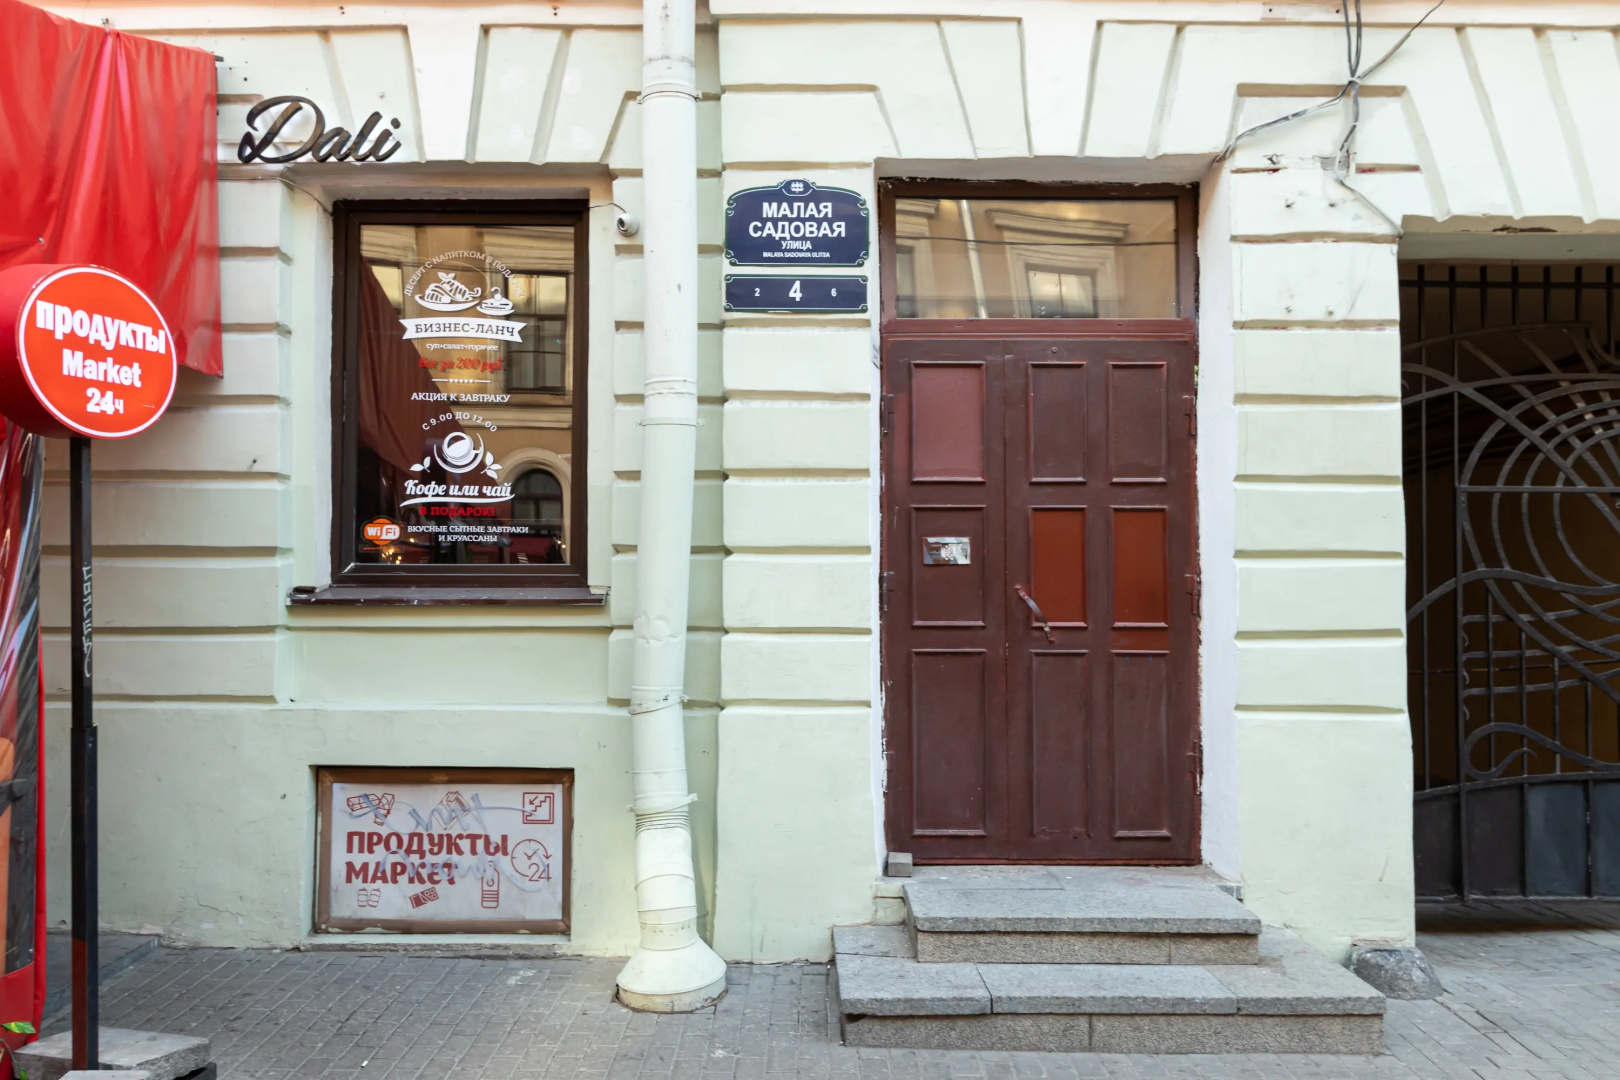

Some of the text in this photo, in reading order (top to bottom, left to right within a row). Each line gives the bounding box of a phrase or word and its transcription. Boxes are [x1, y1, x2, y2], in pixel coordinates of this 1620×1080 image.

[237, 95, 402, 164] Dali
[762, 202, 832, 218] МАЛАЯ
[748, 221, 846, 240] САДОВАЯ
[781, 240, 812, 251] УЛИЦА
[404, 266, 426, 297] ДЕСЕРТ
[425, 261, 433, 269] С
[432, 250, 486, 265] НАПИТКОМ
[486, 255, 493, 264] В
[754, 280, 837, 302] 2 4 6
[36, 300, 166, 354] продукты
[414, 323, 516, 337] БИЗНЕС-ЛАНЧ
[62, 349, 142, 388] Market
[440, 359, 454, 371] за
[455, 357, 479, 370] 200
[85, 387, 124, 415] 24ч
[411, 392, 511, 403] АКЦИЯ К ЗАВТРАКУ
[430, 412, 453, 426] 9.00
[455, 412, 470, 420] ДО
[472, 414, 497, 432] 12.00
[404, 479, 512, 498] Кофе или чай
[419, 506, 496, 517] В ПОДАРОК!
[407, 525, 529, 534] ВКУСНЫЕ СЫТНЫЕ ЗАВТРАКИ
[346, 831, 509, 860] ПРОДУКТЫ
[345, 861, 459, 886] МАРКЕТ
[528, 862, 552, 882] 24
